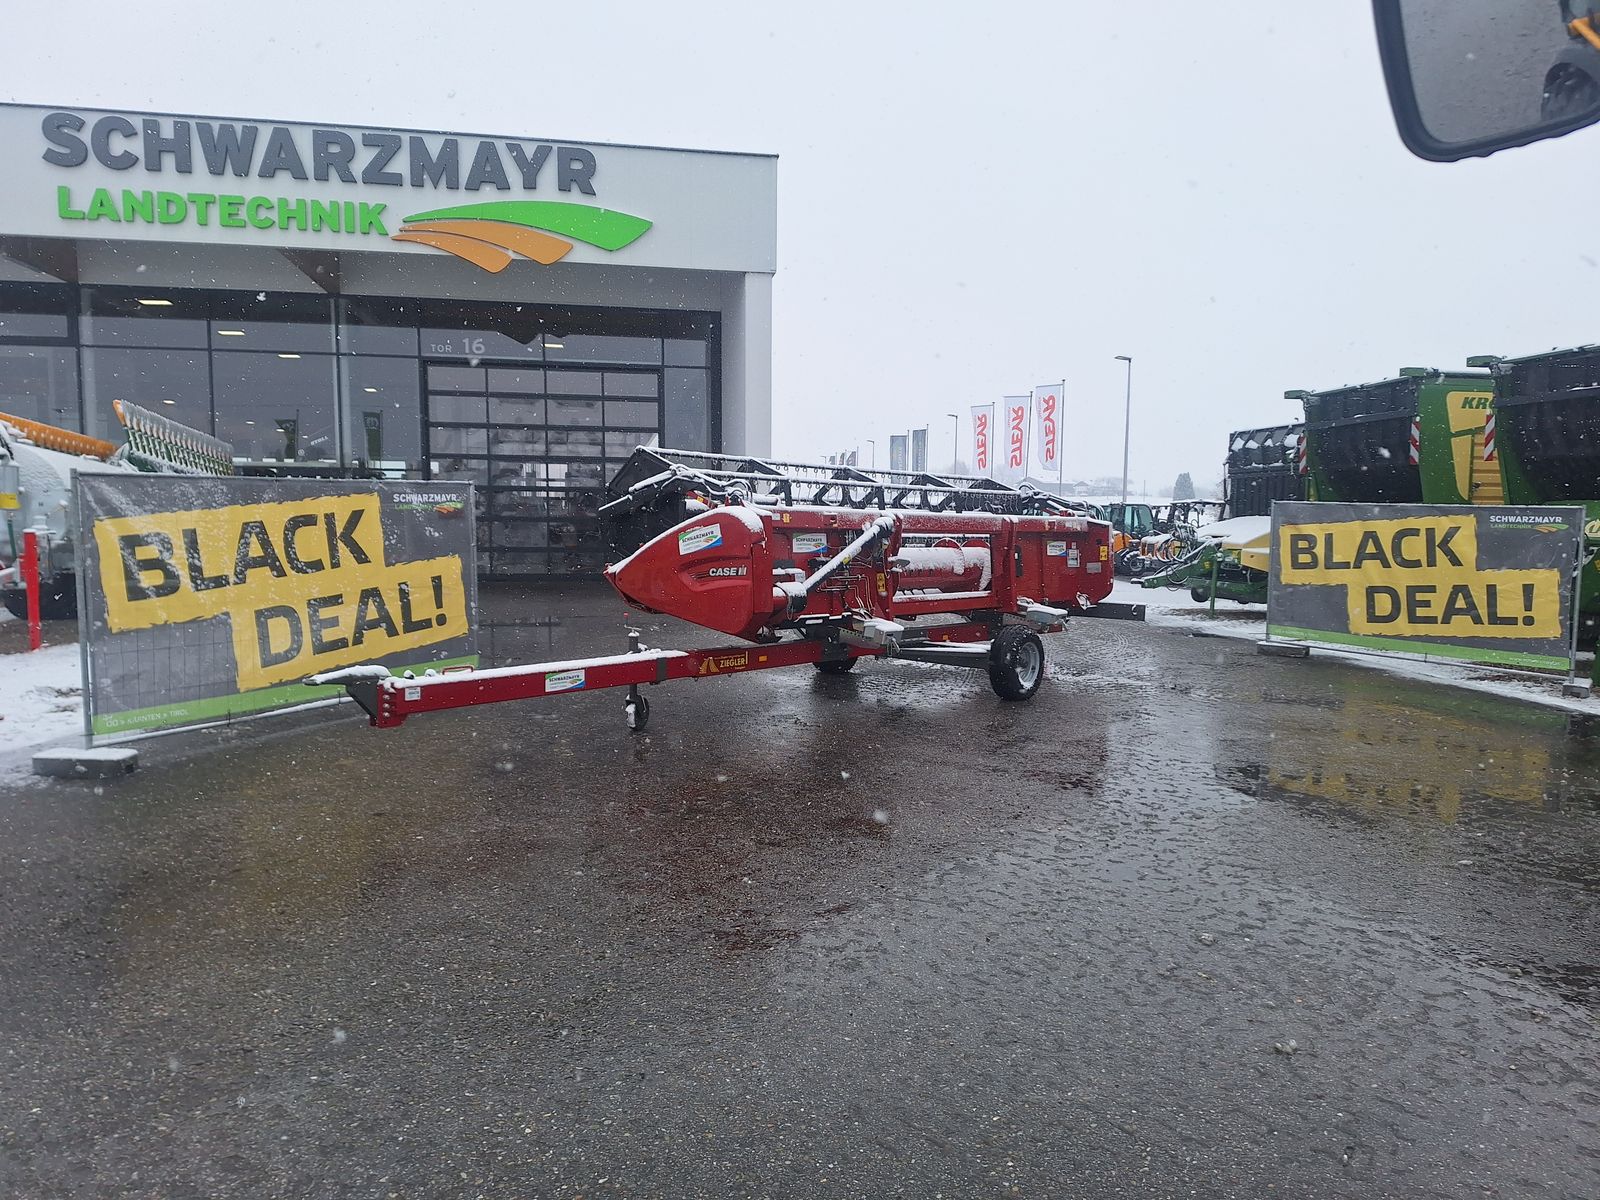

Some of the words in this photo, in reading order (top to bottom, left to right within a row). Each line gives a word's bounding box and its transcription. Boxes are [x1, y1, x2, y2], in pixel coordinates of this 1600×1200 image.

[42, 112, 597, 196] SCHWARZMAYR
[57, 185, 389, 236] LANDTECHNIK
[430, 344, 452, 353] TOR
[463, 337, 486, 354] 16
[392, 493, 457, 503] SCHWARZMAYR
[1489, 515, 1563, 523] SCHWARZMAYR
[681, 530, 715, 543] SCHWARZMAYR
[1290, 526, 1465, 570] BLACK
[117, 508, 372, 602] BLACK
[709, 567, 737, 576] CASE
[1365, 583, 1536, 627] DEAL!
[253, 575, 448, 669] DEAL!
[720, 657, 746, 668] ZIEGLER
